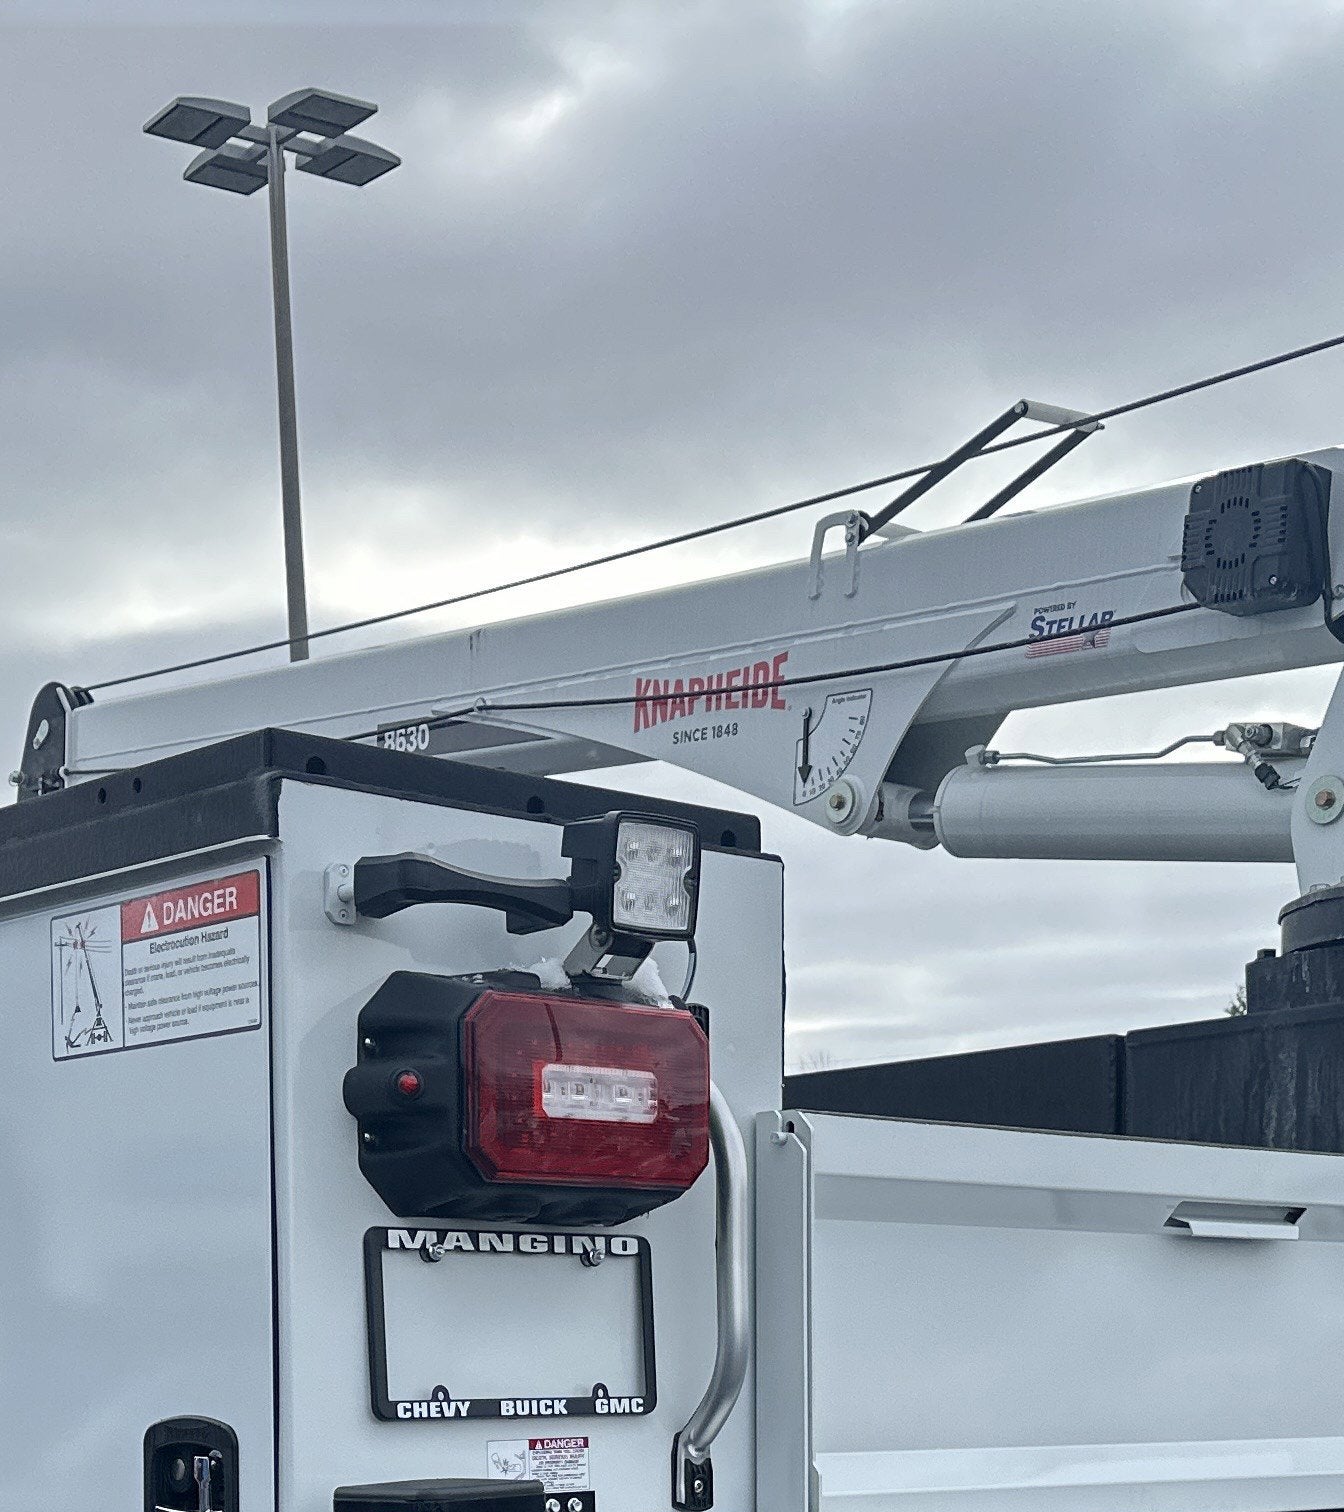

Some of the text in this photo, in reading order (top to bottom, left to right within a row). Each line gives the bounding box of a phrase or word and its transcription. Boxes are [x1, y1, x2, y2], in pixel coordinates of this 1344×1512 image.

[1066, 601, 1077, 610] BY
[1028, 610, 1114, 638] STELLAR
[634, 651, 789, 734] KNAPHEIDE
[383, 723, 430, 753] 8630
[672, 722, 739, 745] SINCE 1848
[162, 886, 238, 926] DANGER
[150, 927, 229, 955] Electrocution Hazard
[387, 1229, 639, 1256] MANGINO
[396, 1397, 645, 1419] CHEVY BUICK GMC
[543, 1438, 585, 1449] DANGER
